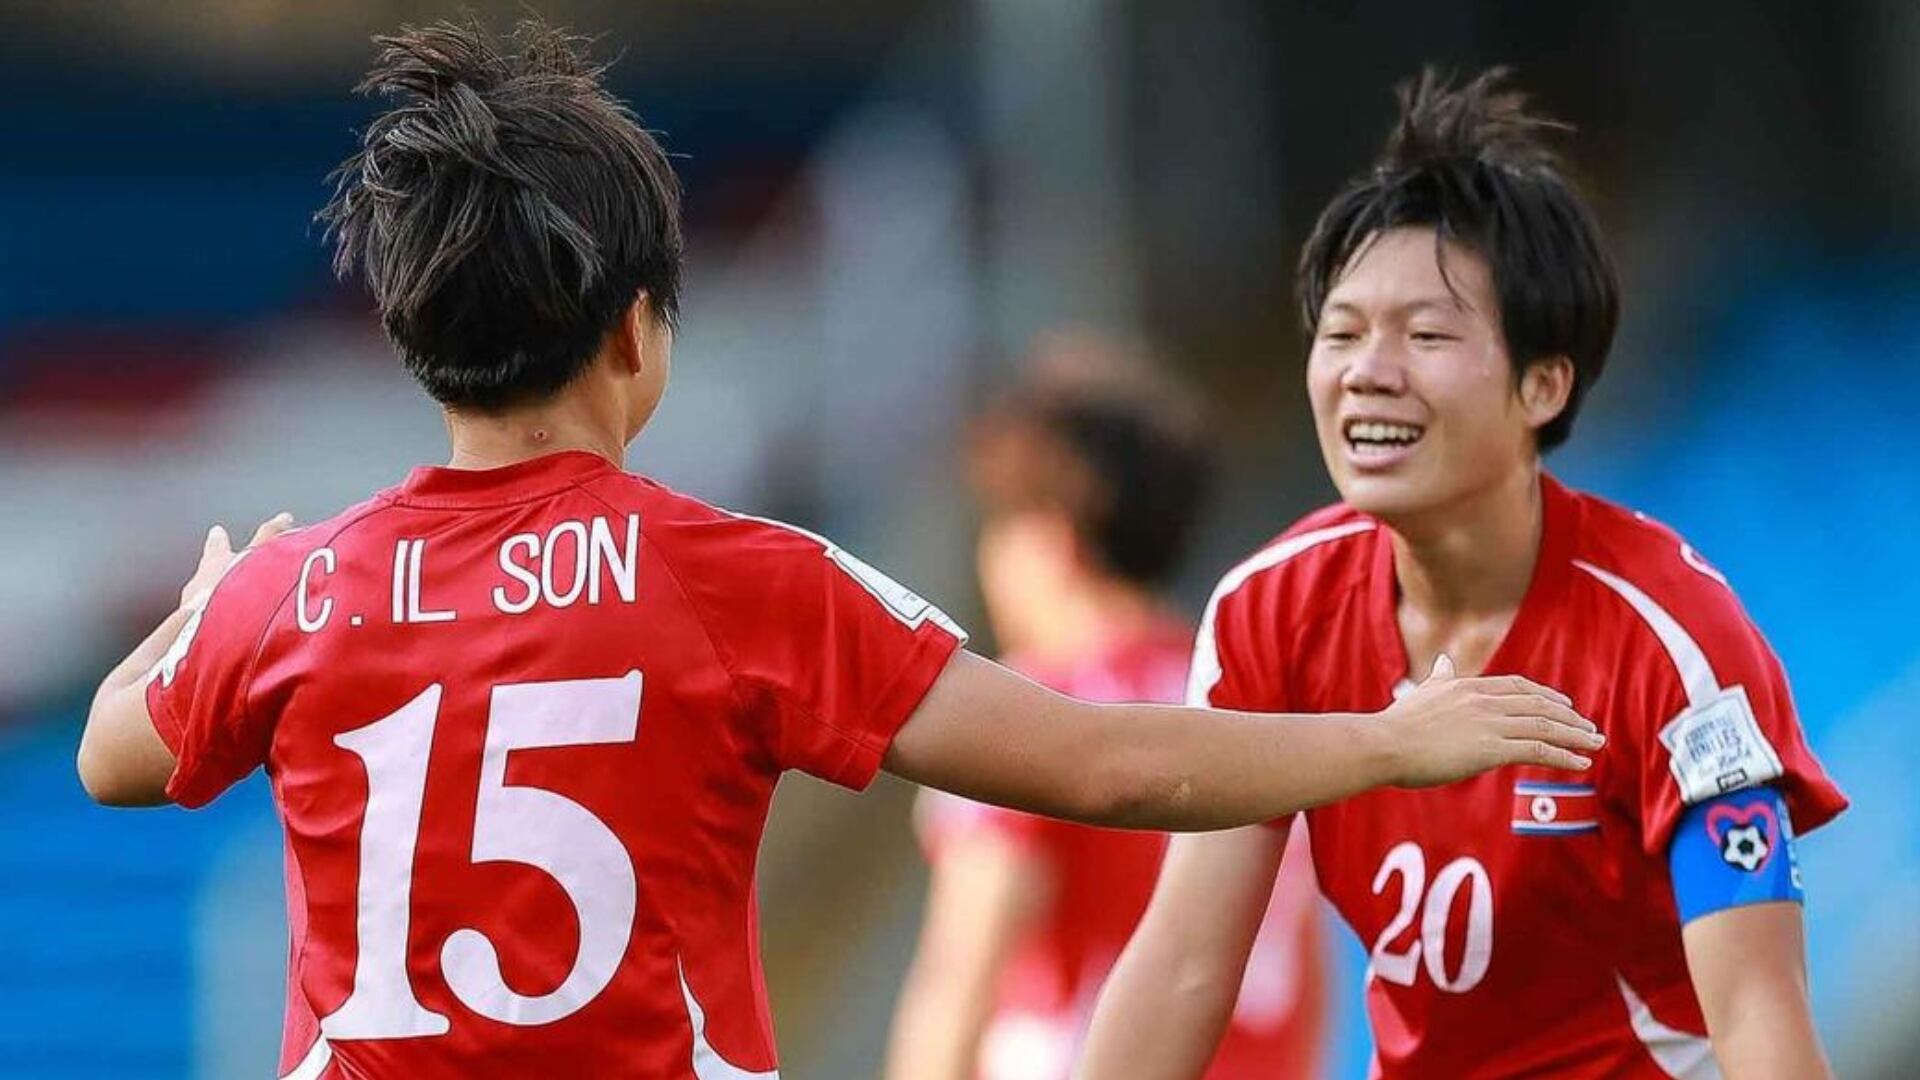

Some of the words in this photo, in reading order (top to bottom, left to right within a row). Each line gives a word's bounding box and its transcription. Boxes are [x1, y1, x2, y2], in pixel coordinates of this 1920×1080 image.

[392, 539, 457, 623] IL
[492, 514, 640, 614] SON
[320, 669, 643, 1040] 15
[1372, 841, 1493, 993] 20
